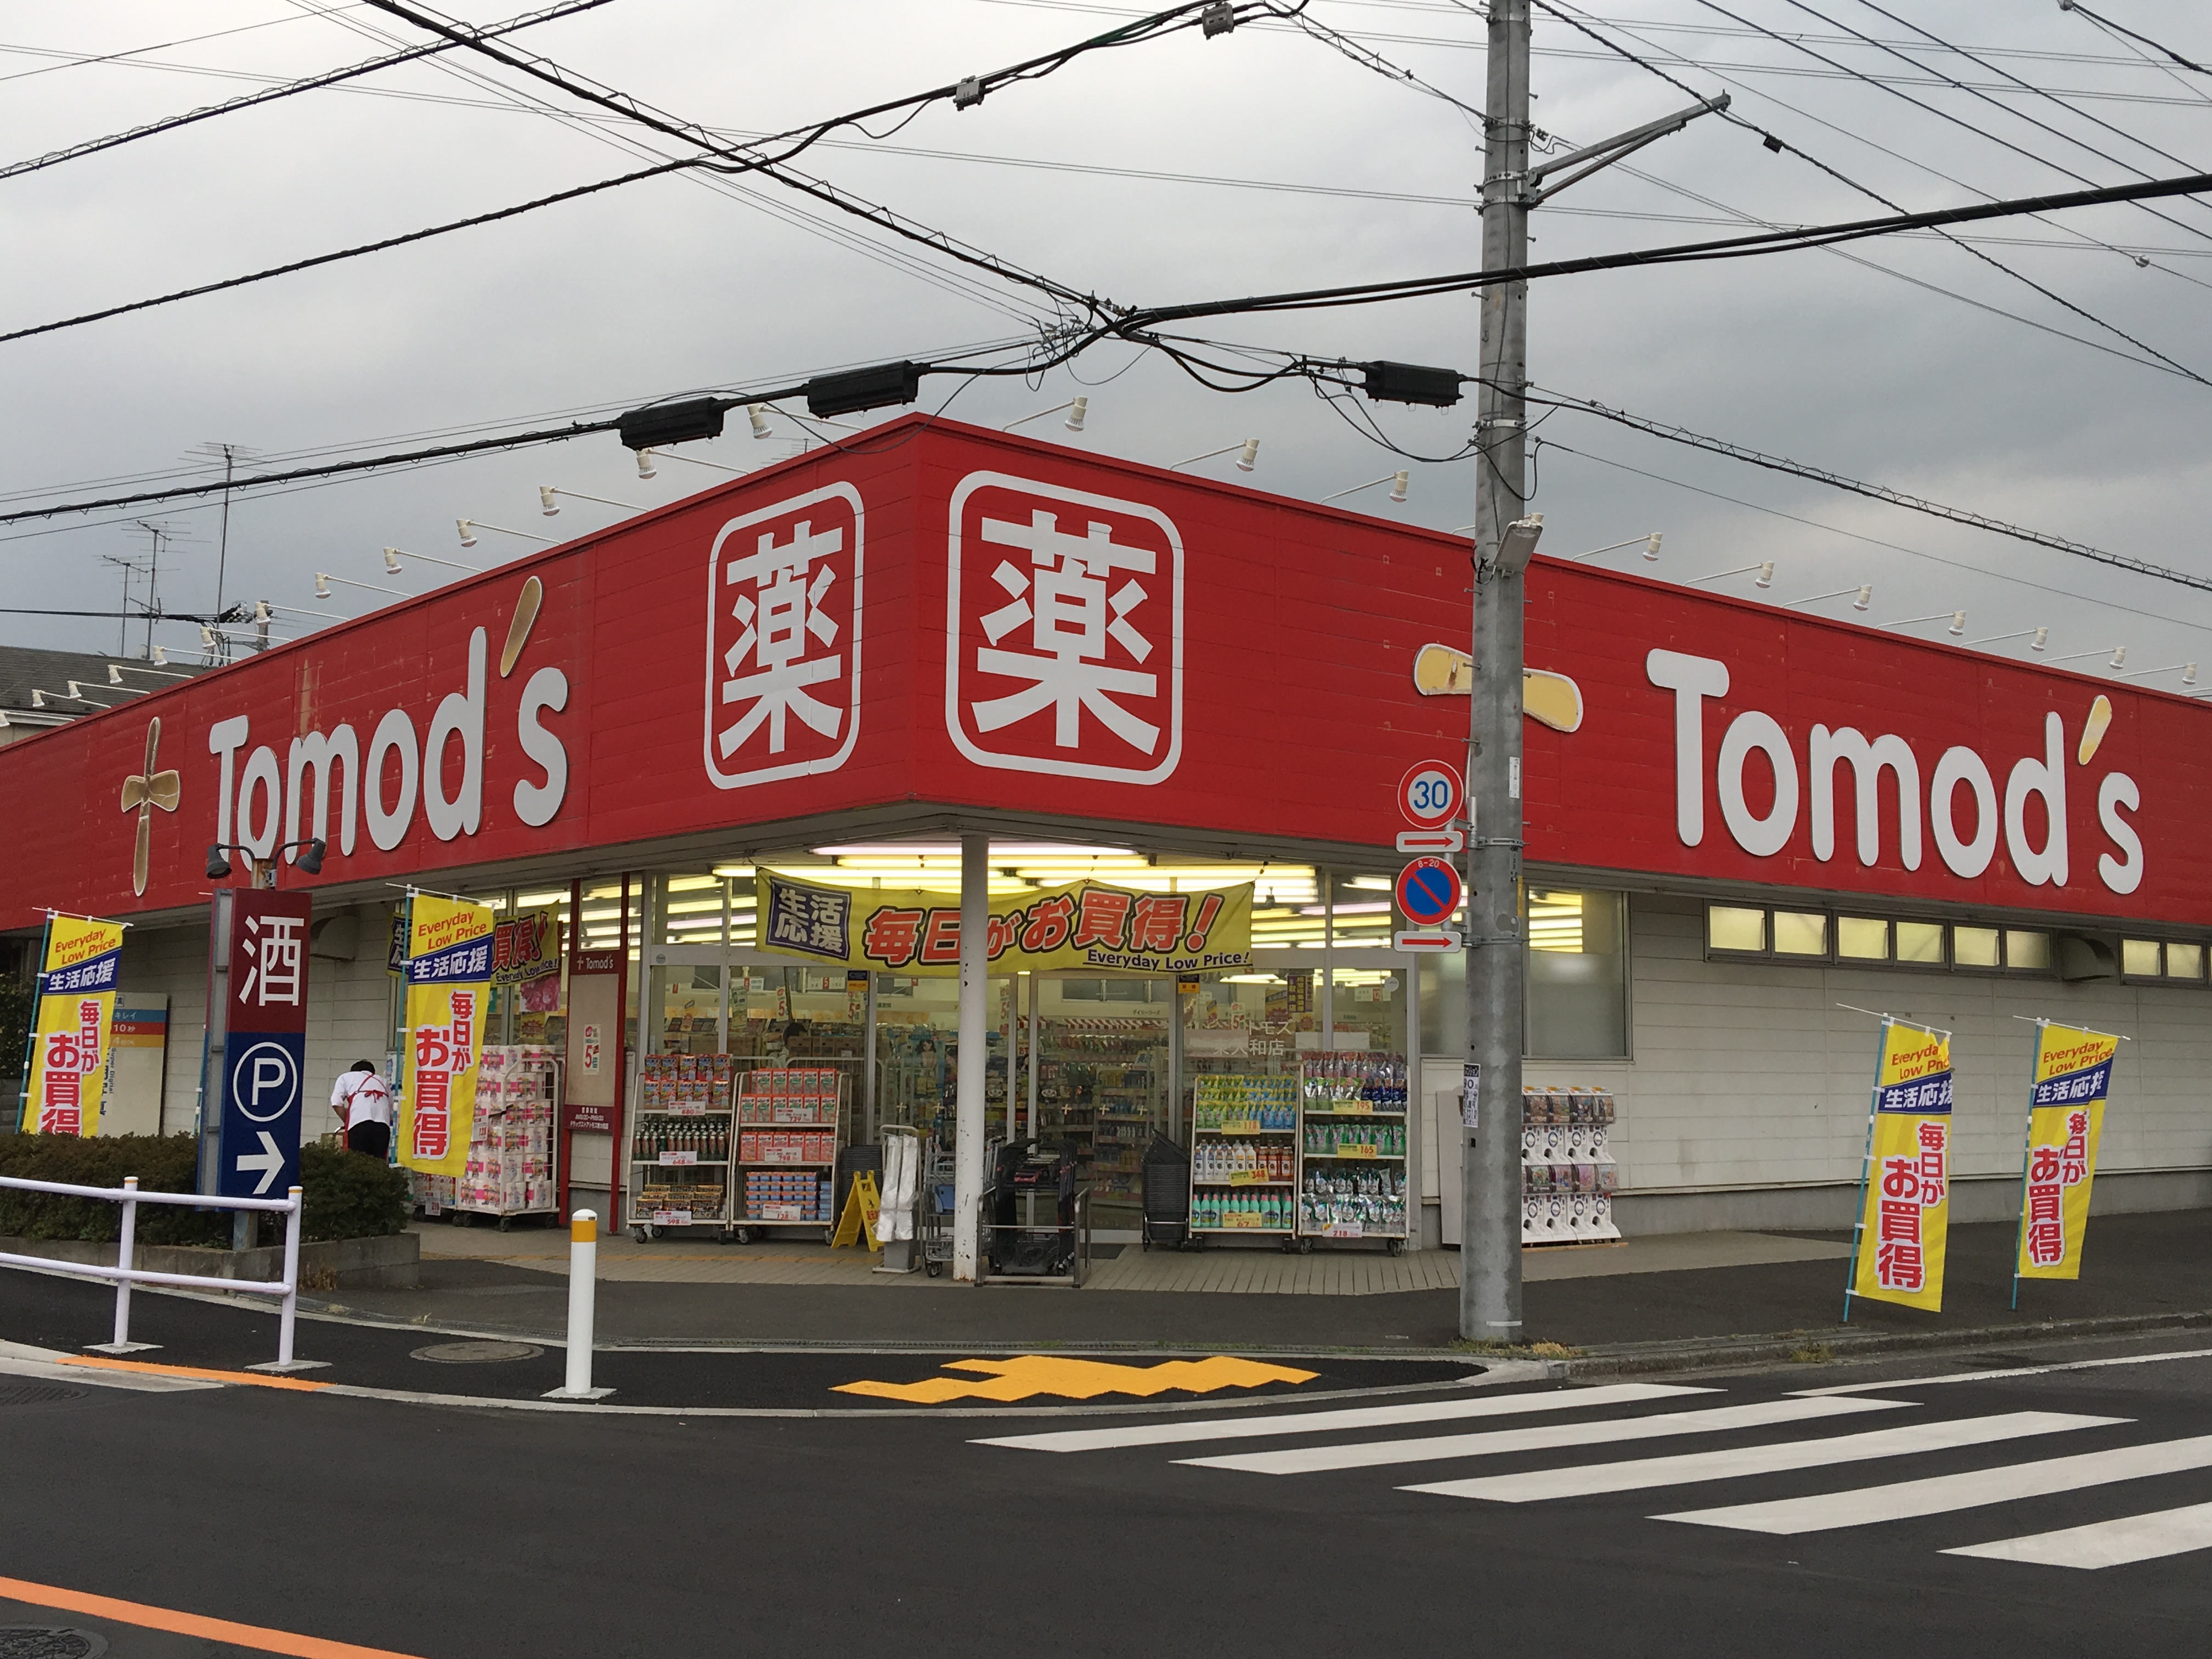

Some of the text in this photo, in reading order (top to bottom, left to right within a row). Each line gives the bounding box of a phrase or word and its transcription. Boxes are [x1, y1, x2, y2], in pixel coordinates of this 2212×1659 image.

[719, 520, 843, 760] 薬
[972, 509, 1161, 755] 薬
[209, 575, 568, 871] Tomod's
[1646, 648, 2144, 894] Tomod's
[1413, 780, 1448, 809] 30
[1418, 859, 1440, 868] 8-20
[55, 928, 107, 953] Everyday
[418, 911, 475, 938] Everyday
[427, 922, 487, 951] Low Price
[61, 936, 116, 966] Low Price
[239, 915, 304, 1006] 酒
[414, 944, 488, 979] 生活応援
[586, 953, 613, 970] Tomod's
[1087, 949, 1250, 971] Everyday Low Price!
[48, 957, 116, 991] 生活応援
[79, 1001, 100, 1072] 毎日が
[451, 991, 472, 1072] 毎日が
[1892, 1044, 1939, 1065] Everyda
[2043, 1041, 2104, 1063] Everyday
[2049, 1047, 2113, 1075] Low Price
[252, 1058, 286, 1105] P
[1900, 1065, 1923, 1080] Low
[413, 1028, 450, 1156] お買得
[1919, 1122, 1945, 1205] 毎日が
[2029, 1148, 2063, 1263] お買得
[1878, 1159, 1922, 1289] お買得
